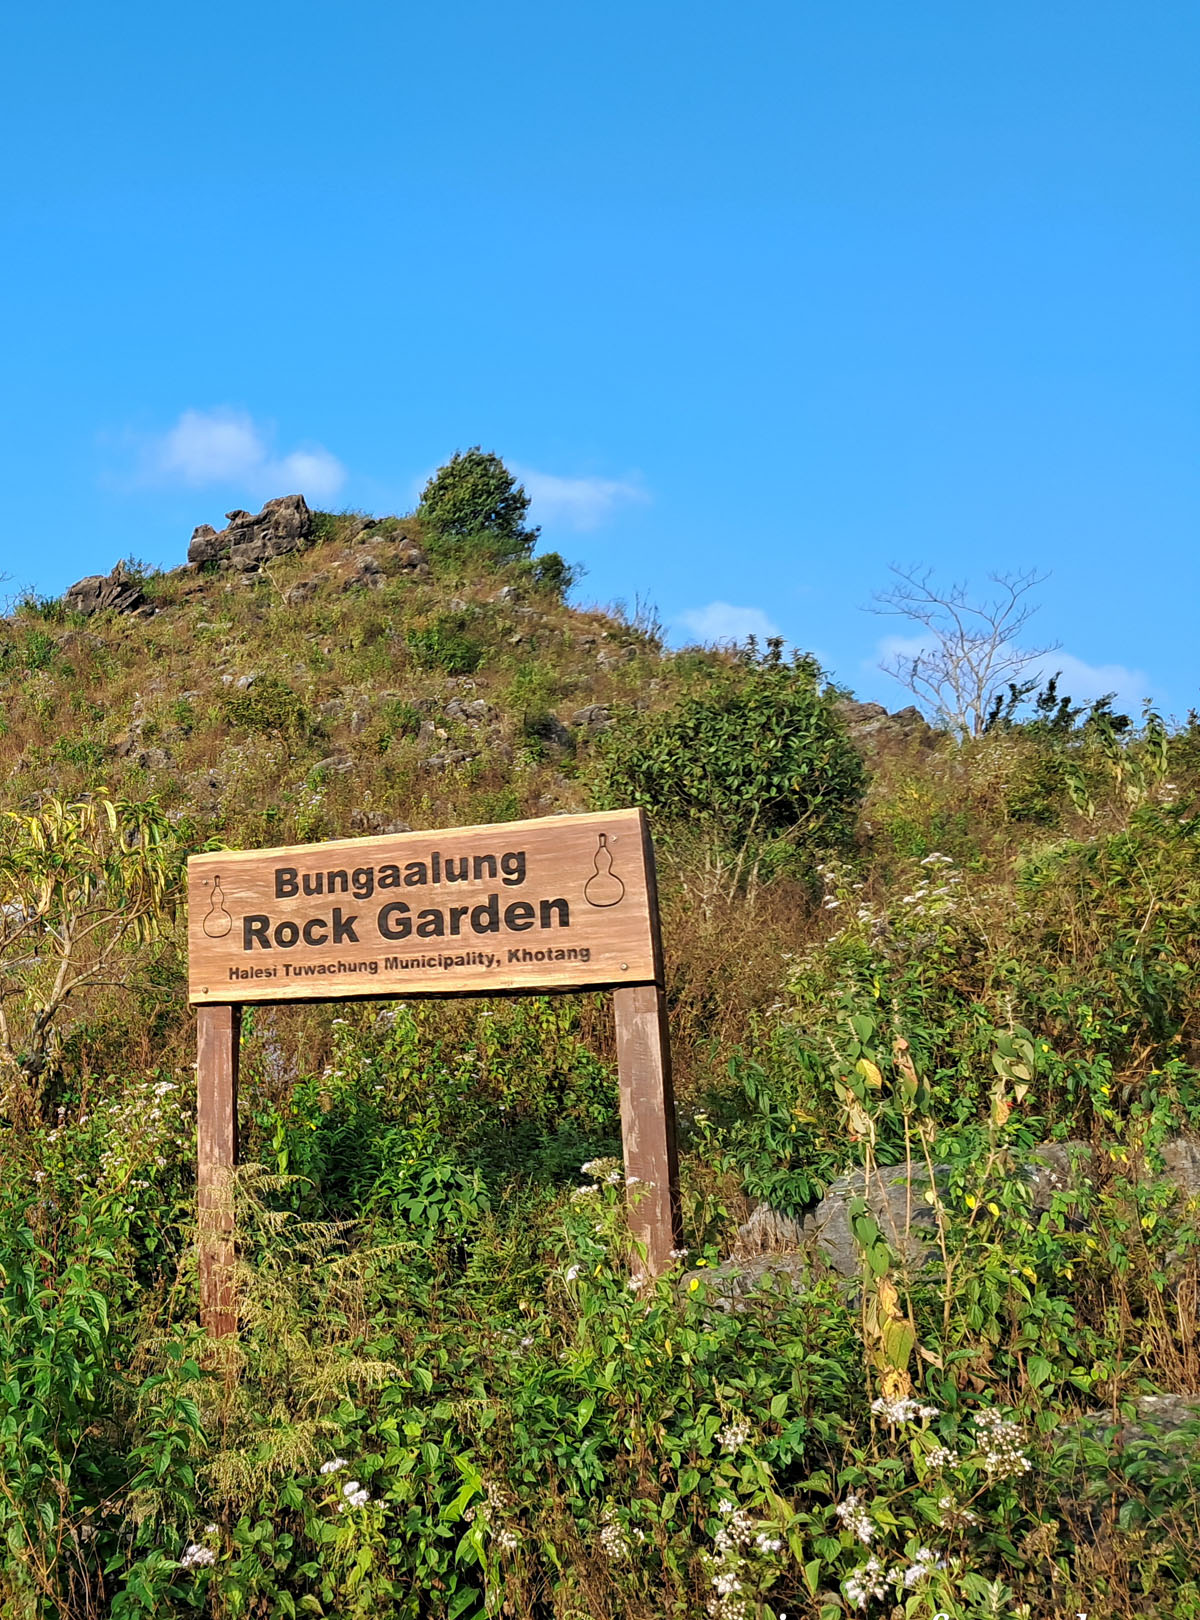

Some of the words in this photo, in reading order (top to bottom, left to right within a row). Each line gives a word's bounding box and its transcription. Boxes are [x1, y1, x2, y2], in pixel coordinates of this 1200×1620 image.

[275, 851, 527, 899] Bungaalung
[243, 906, 360, 951] Rock
[377, 893, 571, 941] Garden
[228, 967, 278, 981] Halesi
[283, 959, 379, 977] Tuwachung
[384, 953, 502, 971] Municipality,
[508, 946, 591, 965] Khotang
